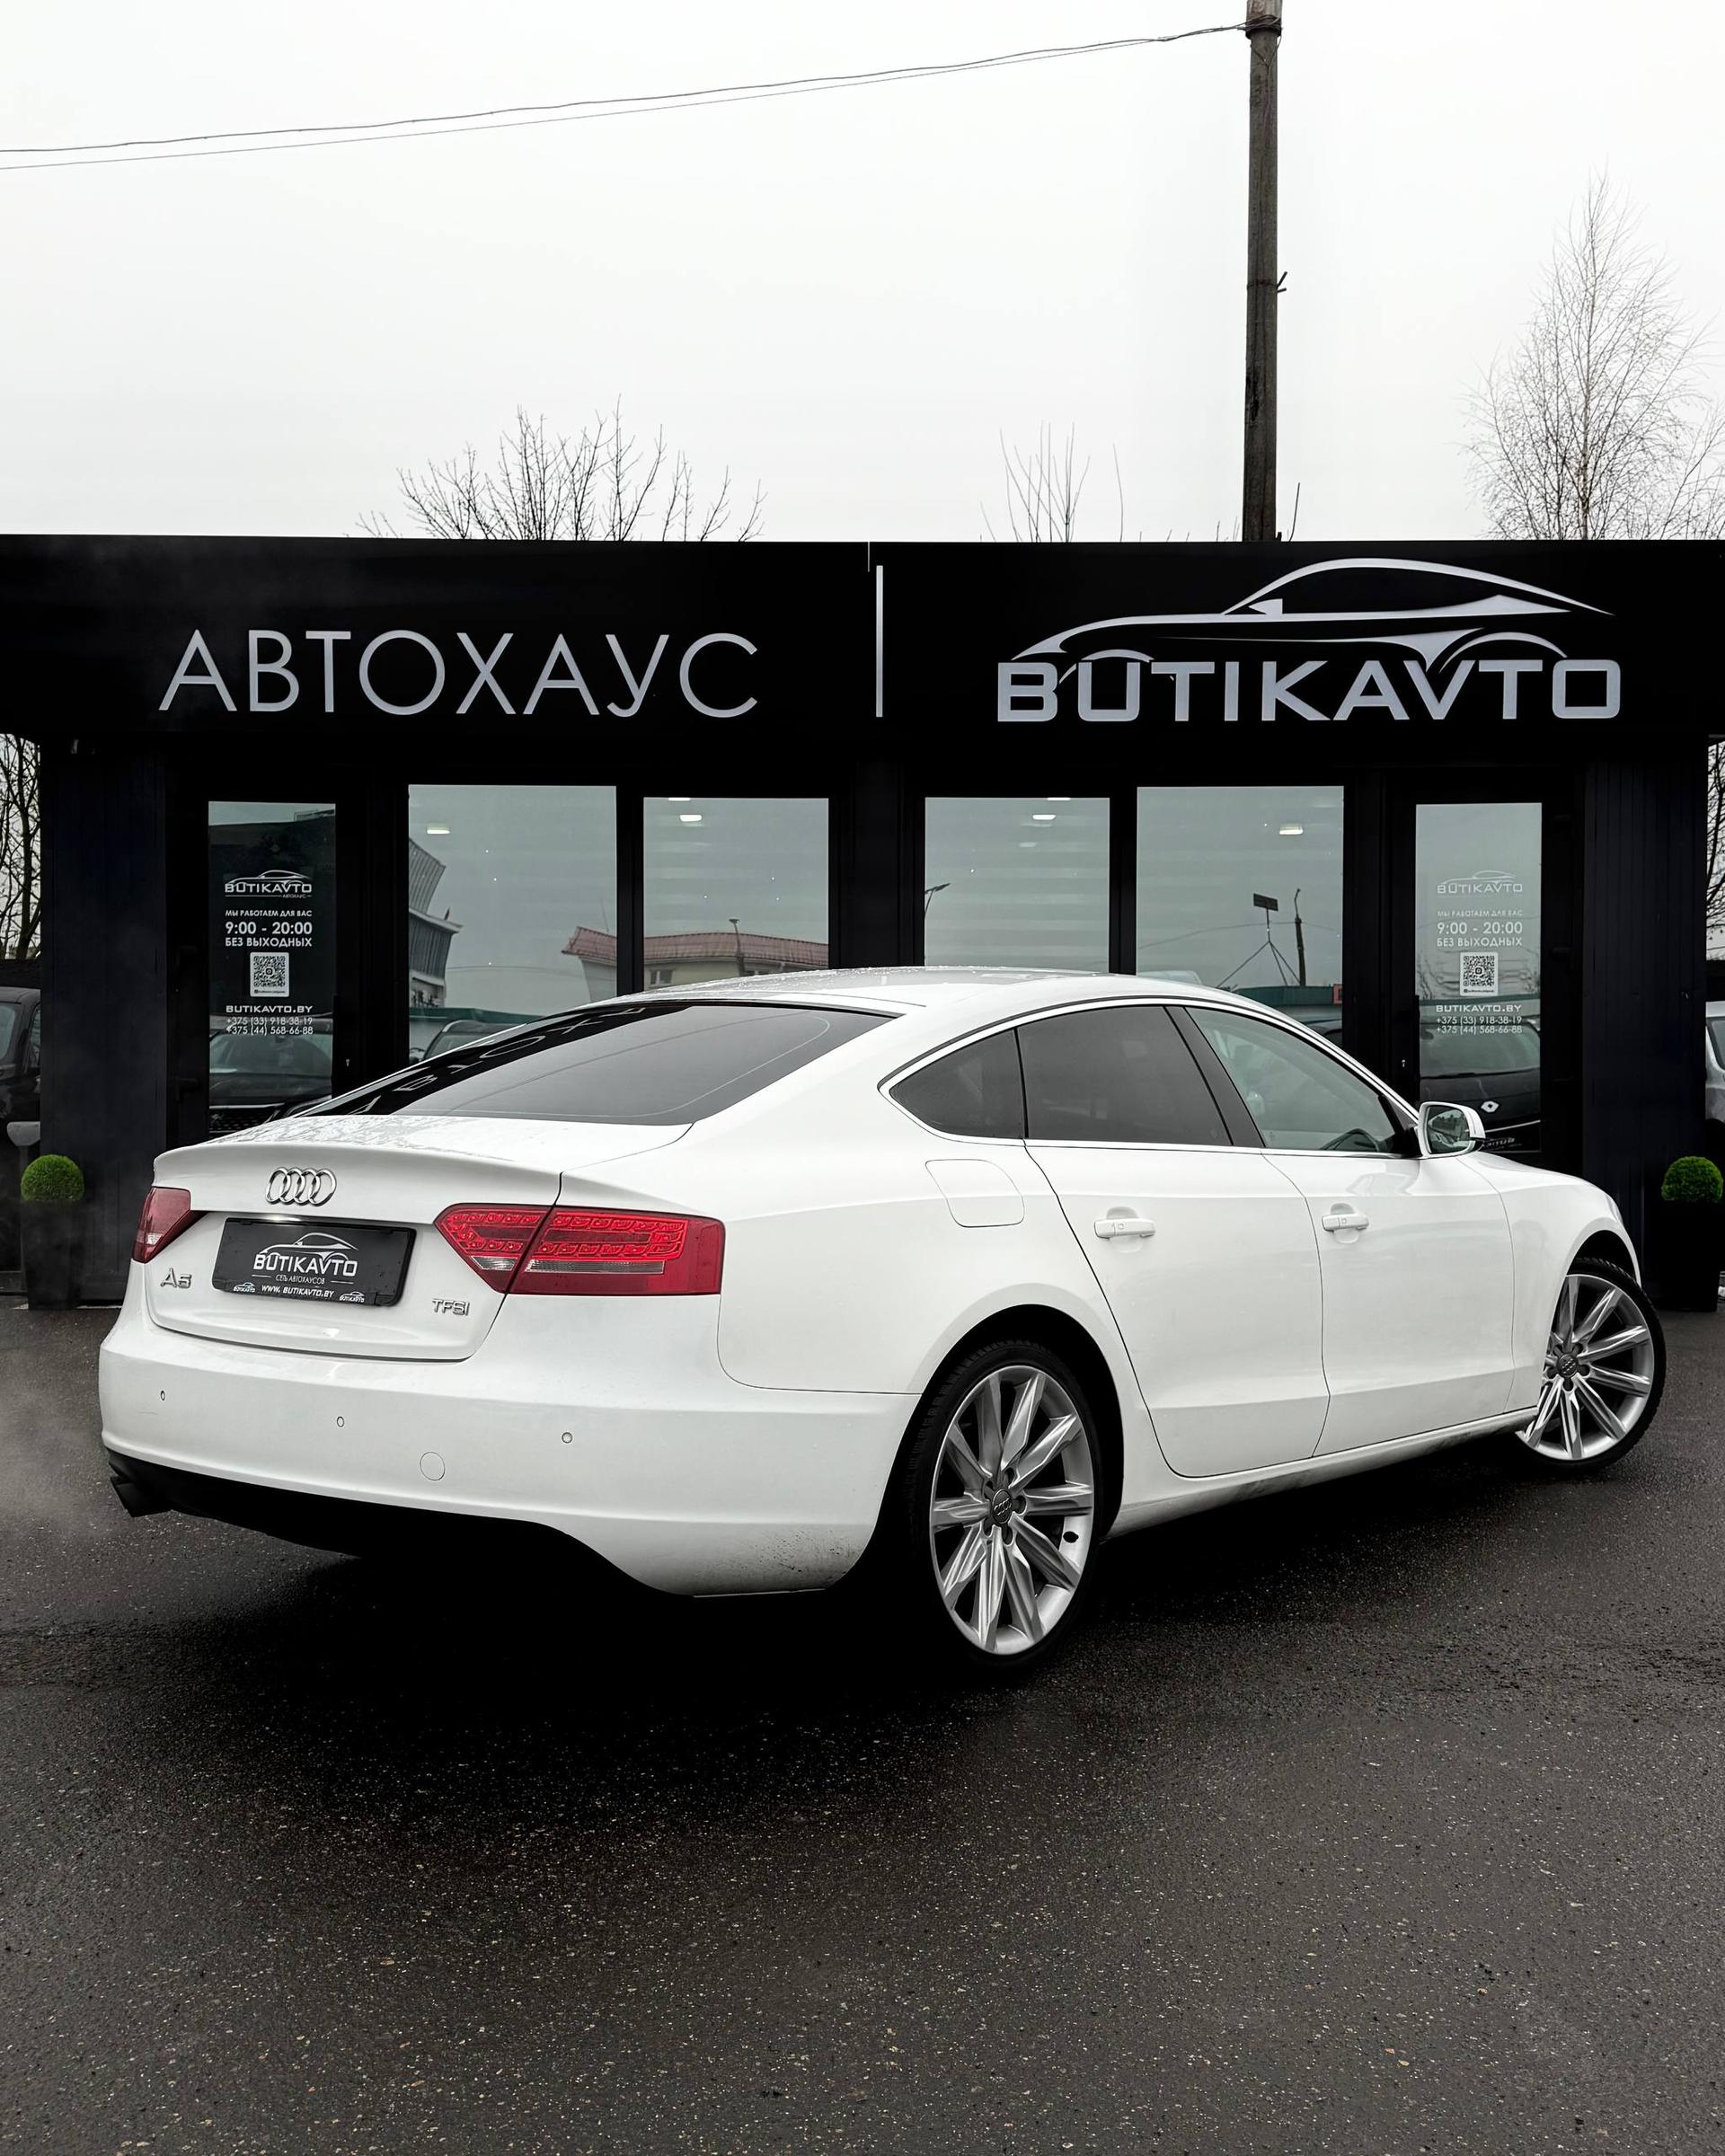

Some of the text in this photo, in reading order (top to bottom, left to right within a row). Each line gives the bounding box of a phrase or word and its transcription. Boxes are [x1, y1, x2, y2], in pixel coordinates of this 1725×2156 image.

[158, 629, 759, 718] АВТОХАУС
[997, 658, 1622, 722] BUTIKAVTO
[225, 883, 313, 893] BUTIKAVTO
[1438, 883, 1523, 894] BUTIKAVTO
[225, 922, 257, 934] 9:00
[271, 922, 313, 934] 20:00
[1438, 922, 1467, 934] 9:00
[1482, 922, 1523, 934] 20:00
[225, 937, 313, 948] БЕЗ ВЫХОДНЫХ
[1438, 937, 1523, 948] БЕЗ ВЫХОДНЫХ
[226, 1005, 313, 1013] BUTIKAVTO.BY
[1436, 1004, 1522, 1012] BUTIKAVTO.BY
[226, 1016, 248, 1025] +375
[270, 1016, 313, 1025] 918-38-19
[1437, 1015, 1522, 1026] +375 (33) 918-38-19
[270, 1026, 314, 1035] 568-66-88
[1437, 1025, 1523, 1035] +375 (44) 568-66-88
[253, 1253, 358, 1277] BUTIKAVTO
[161, 1268, 192, 1288] A5
[283, 1286, 335, 1298] BUTIKAVTO.BY
[432, 1298, 470, 1316] TFSI
